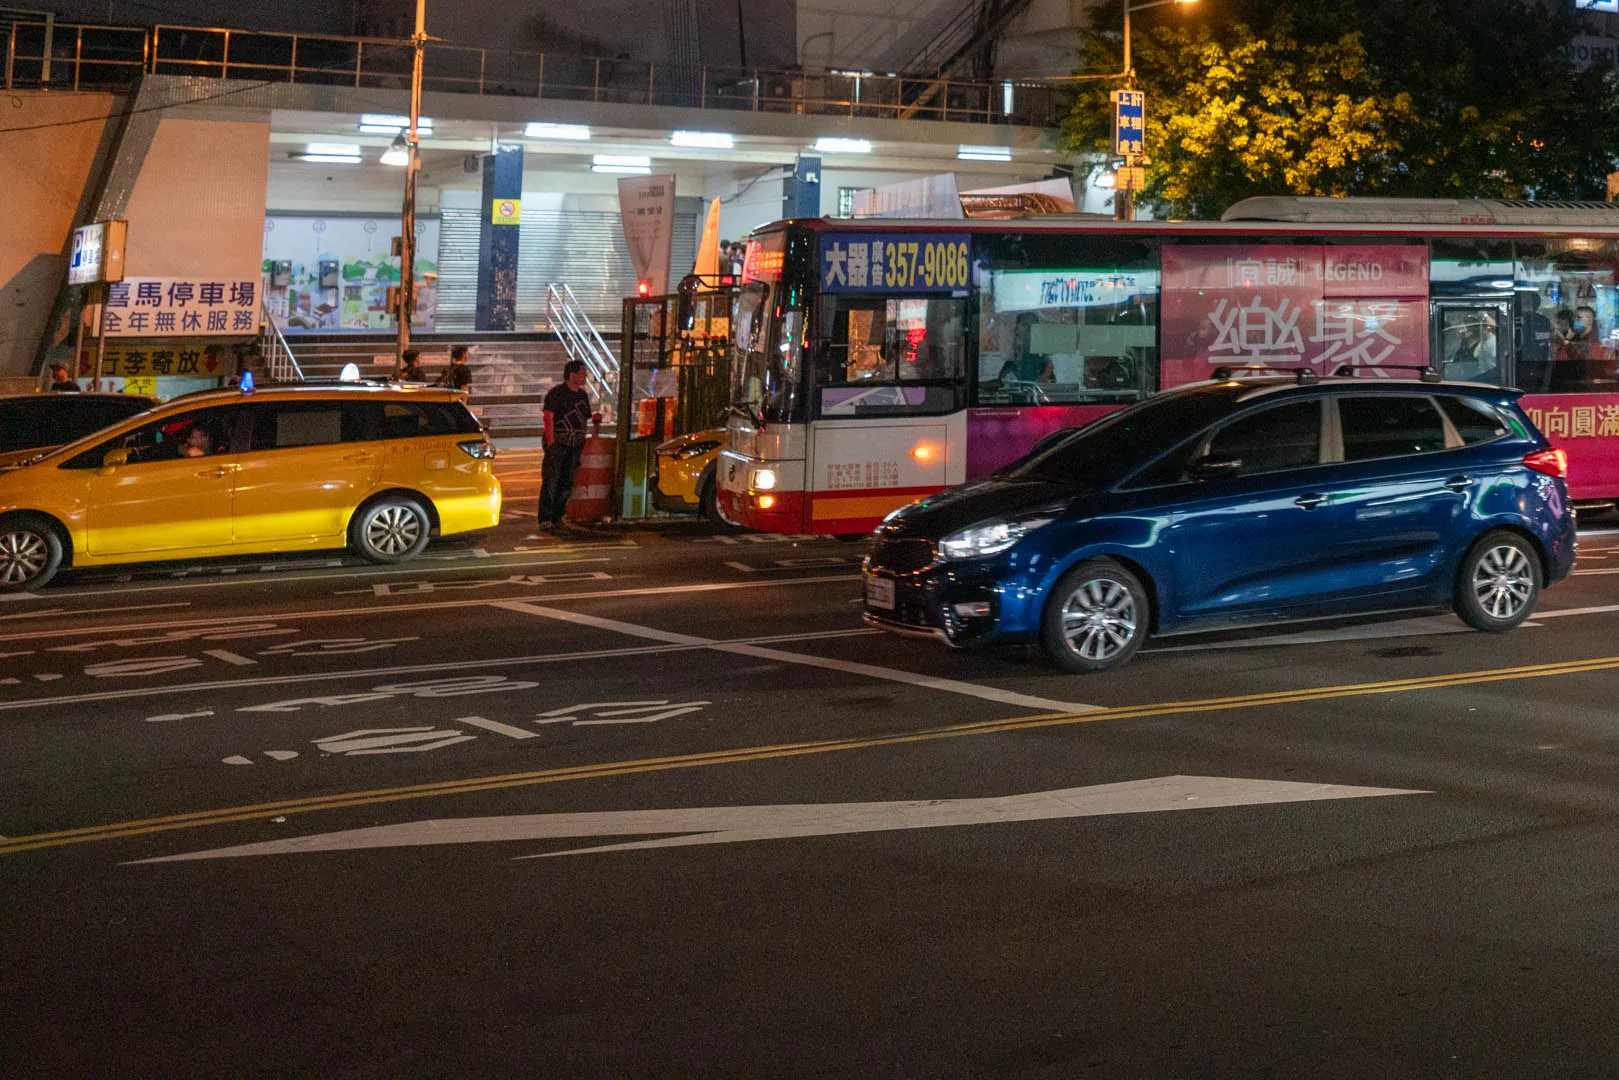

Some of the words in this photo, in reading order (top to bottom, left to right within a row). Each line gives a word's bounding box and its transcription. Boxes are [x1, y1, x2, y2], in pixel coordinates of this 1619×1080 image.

[825, 241, 869, 287] 大器
[885, 240, 969, 288] 357-9086
[1234, 256, 1297, 287] 宜誠
[1314, 263, 1383, 281] LEGEND
[107, 281, 255, 308] 喜馬停車場
[103, 310, 254, 333] 全年無休服務
[1207, 295, 1401, 378] 樂聚
